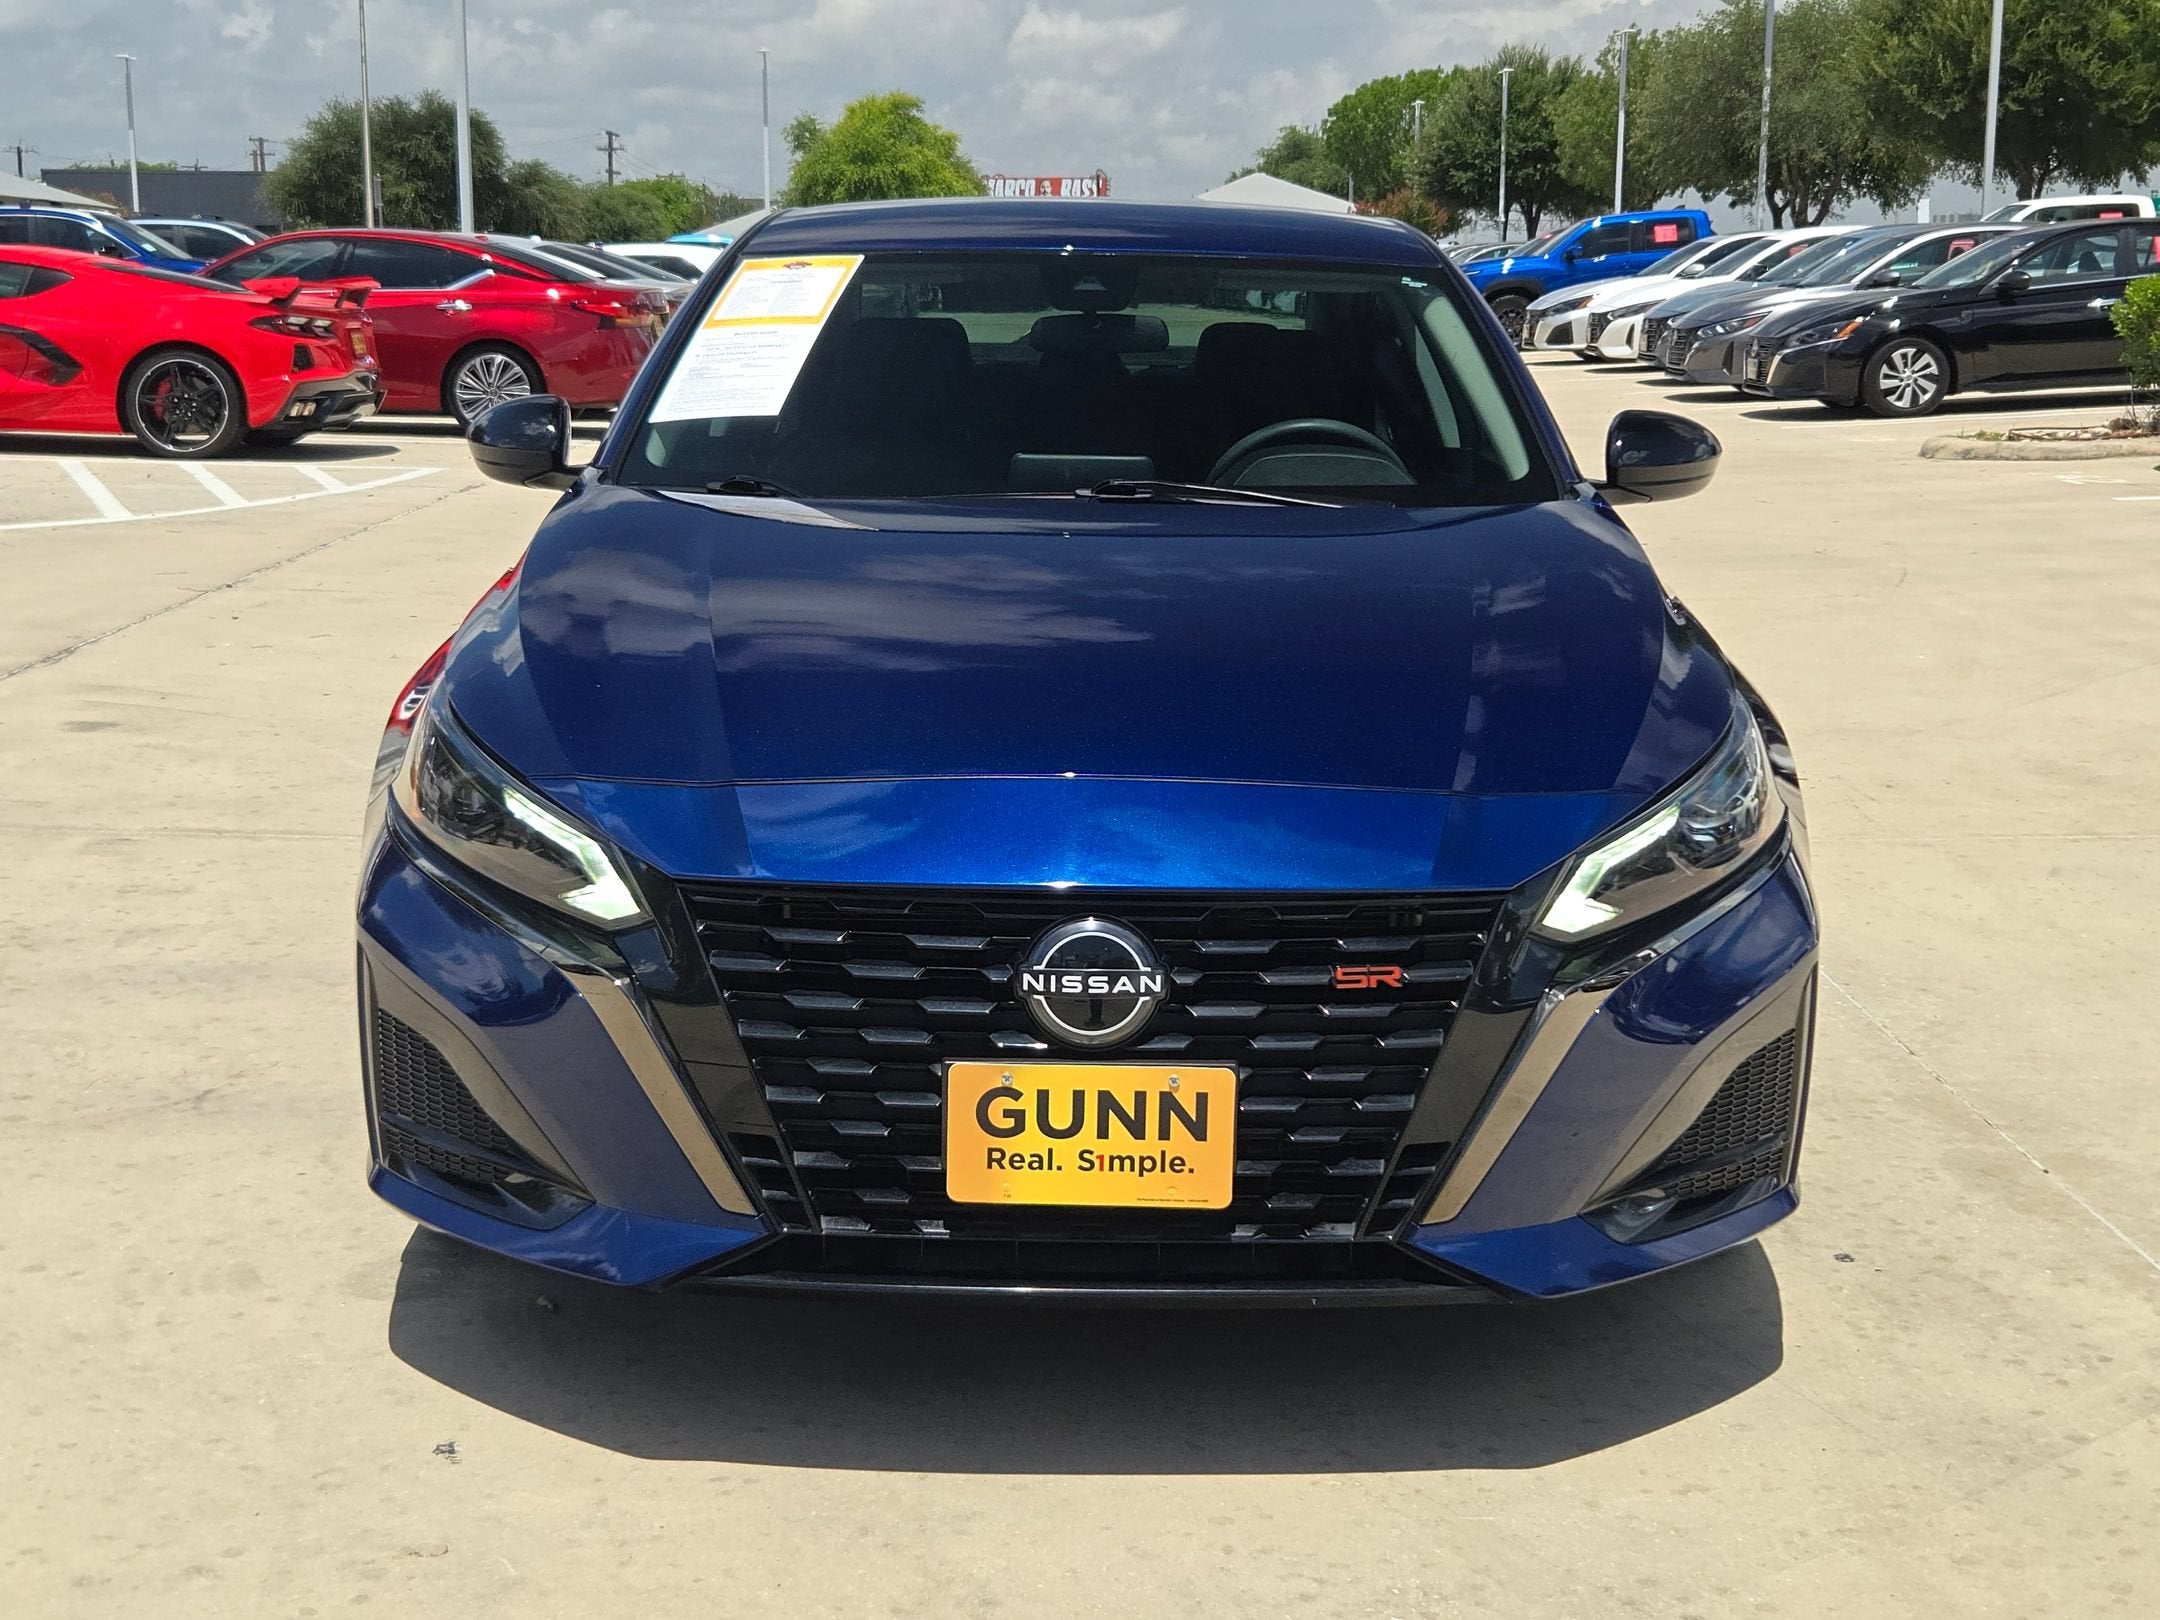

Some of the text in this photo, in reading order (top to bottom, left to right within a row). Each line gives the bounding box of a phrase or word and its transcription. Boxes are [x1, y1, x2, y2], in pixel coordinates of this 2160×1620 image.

[1023, 972, 1162, 994] NISSAN
[1335, 965, 1404, 988] SR
[975, 1085, 1209, 1142] GUNN
[986, 1147, 1195, 1178] Real. S1mple.
